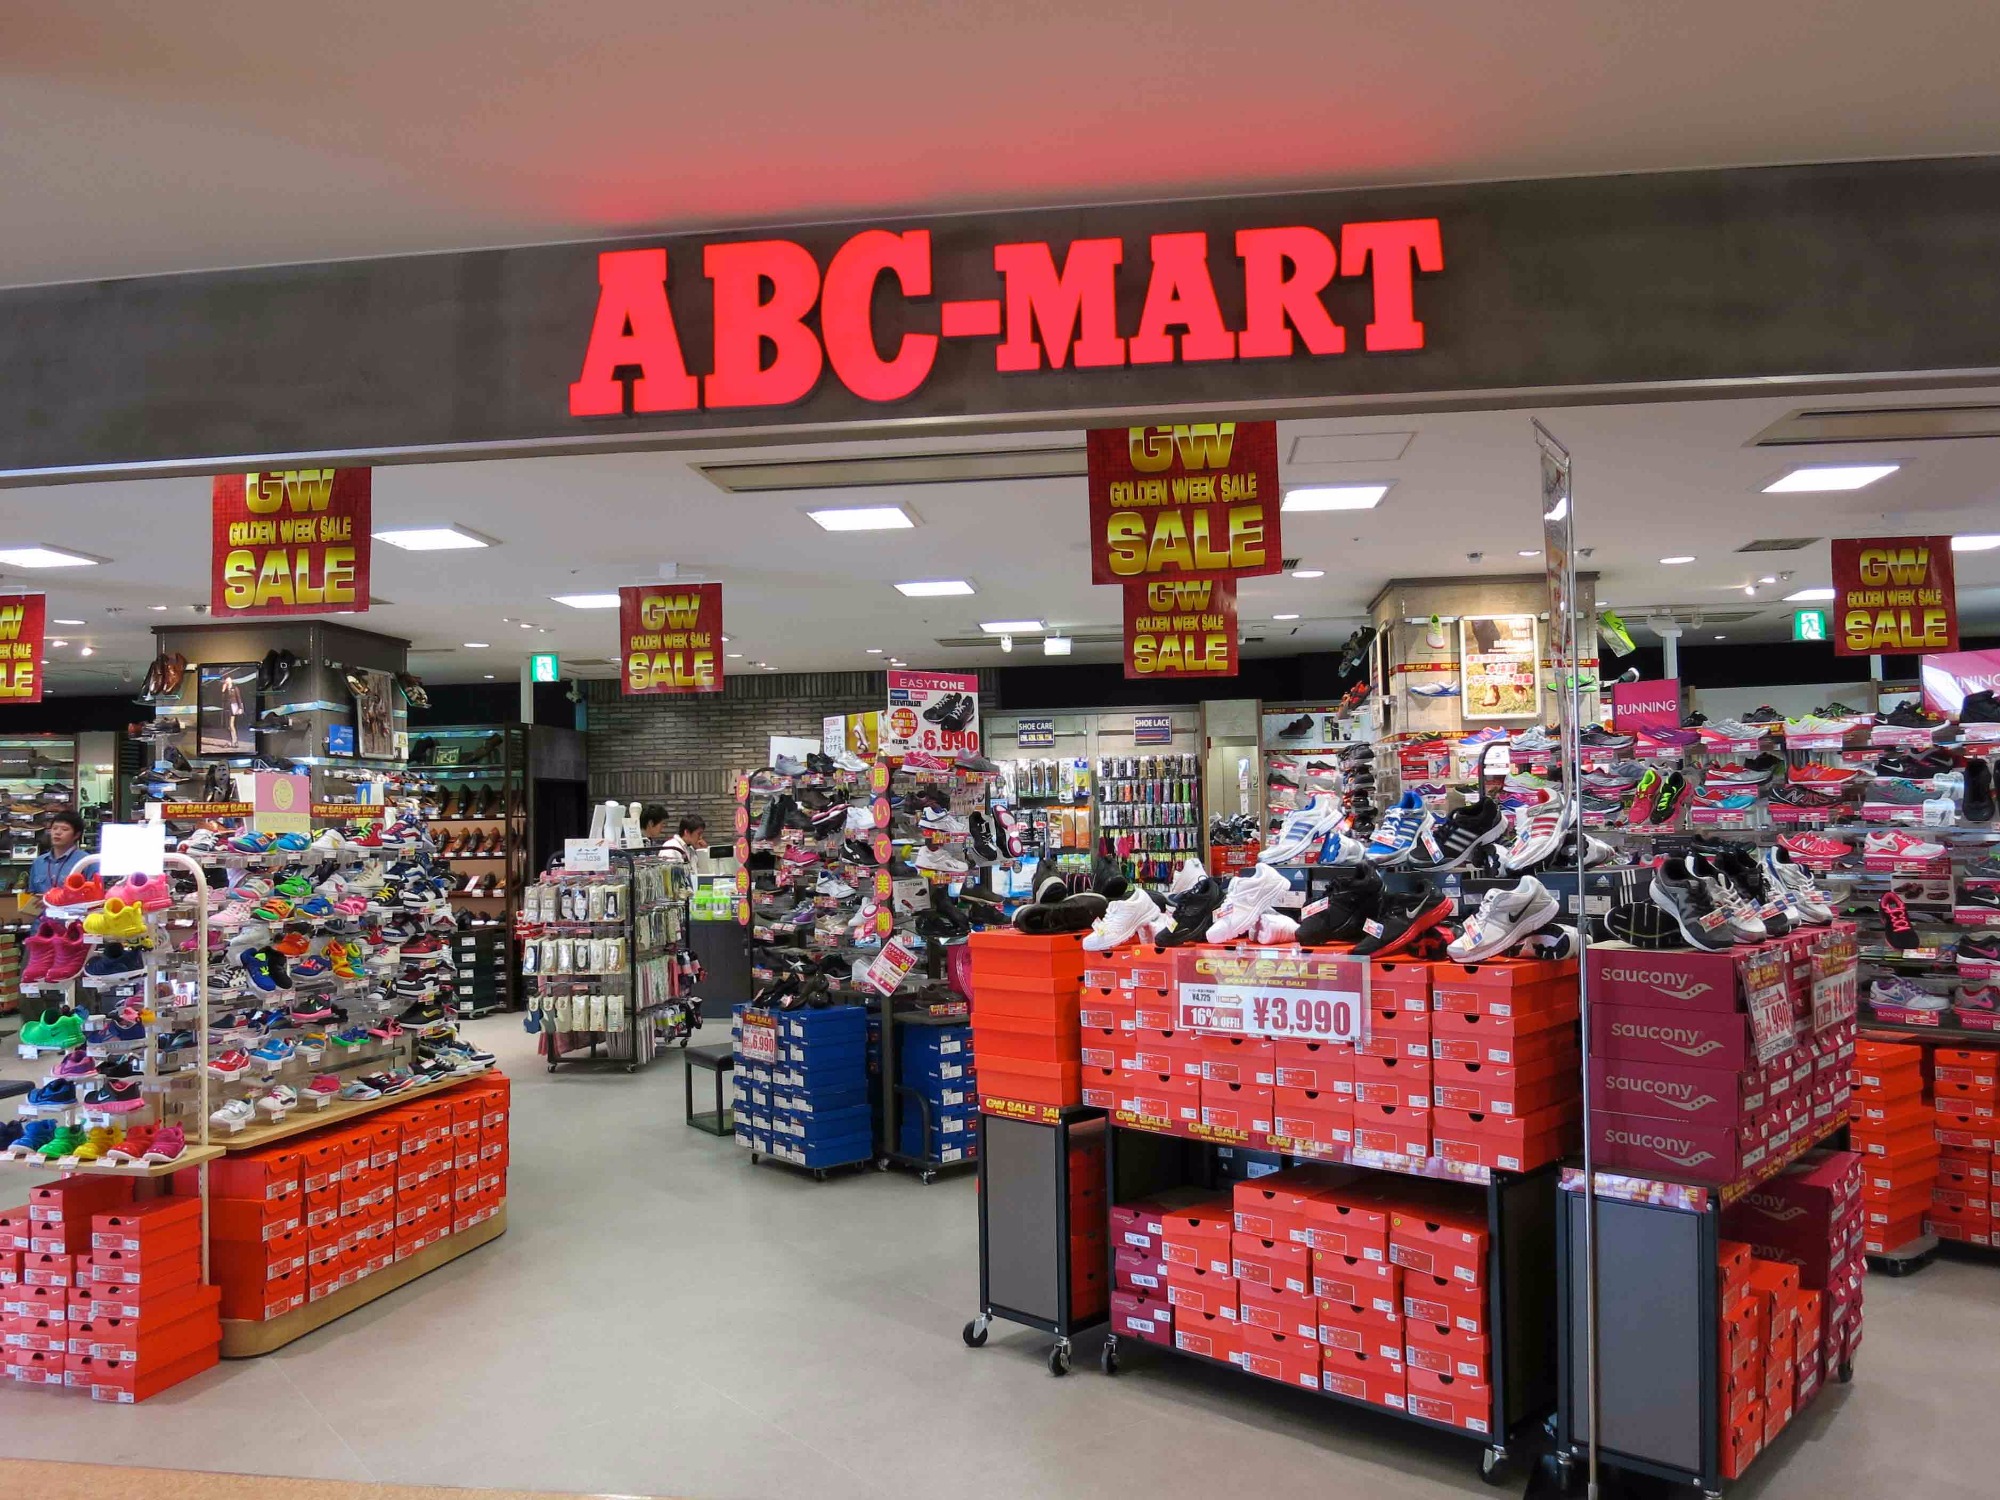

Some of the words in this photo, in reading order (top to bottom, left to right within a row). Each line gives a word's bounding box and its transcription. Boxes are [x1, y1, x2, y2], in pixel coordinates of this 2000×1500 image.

[569, 218, 1444, 418] ABC-MART
[1128, 422, 1237, 473] GW
[246, 468, 336, 514] GW
[1109, 478, 1168, 508] GOLDEN
[1171, 475, 1217, 505] WEEK
[1220, 472, 1258, 502] SALE
[229, 520, 276, 547] GOLDEN
[280, 517, 317, 544] WEEK
[319, 515, 352, 542] SALE
[1107, 504, 1266, 577] SALE
[1859, 547, 1930, 587] GW
[224, 547, 356, 610] SALE
[1148, 579, 1213, 613] GW
[1847, 590, 1885, 608] GOLDEN
[1887, 589, 1916, 607] WEEK
[1918, 588, 1942, 606] SALE
[0, 604, 25, 641] W
[641, 593, 701, 631] GW
[1135, 615, 1171, 633] GOLDEN
[1172, 614, 1200, 632] WEEK
[1201, 613, 1224, 631] SALE
[1845, 608, 1949, 651] SALE
[0, 643, 12, 660] EEK
[13, 642, 32, 660] SALE
[630, 634, 662, 651] GOLDEN
[663, 633, 689, 650] WEEK
[690, 631, 711, 649] SALE
[1133, 633, 1229, 674] SALE
[0, 661, 34, 698] LE
[628, 651, 715, 690] SALE
[899, 678, 966, 691] EASYTONE
[1617, 699, 1677, 716] RUNNING
[1019, 722, 1036, 732] SHOE
[1036, 721, 1053, 731] CARE
[1135, 718, 1153, 728] SHOE
[1153, 717, 1169, 728] LACE
[923, 730, 979, 752] 6,990
[167, 804, 185, 814] GW
[186, 804, 212, 813] SALE
[212, 804, 229, 814] GW
[230, 803, 253, 812] SALE
[312, 806, 330, 814] GW
[331, 806, 347, 814] SALE
[362, 806, 381, 814] SALE
[1195, 958, 1249, 976] GW
[1255, 960, 1338, 981] SALE
[1601, 967, 1688, 989] saucony
[1192, 993, 1211, 1002] ¥4,725
[1190, 1007, 1218, 1027] 16%
[1253, 996, 1351, 1036] ¥3,990
[752, 1034, 774, 1053] 6,990
[1611, 1022, 1699, 1046] saucony
[1605, 1075, 1693, 1100] saucony
[986, 1097, 1006, 1109] GW
[1007, 1101, 1036, 1115] SALE
[1115, 1110, 1139, 1124] GW
[1139, 1114, 1172, 1128] SALE
[1188, 1123, 1213, 1136] GW
[1214, 1126, 1249, 1141] SALE
[1605, 1128, 1691, 1155] saucony
[1266, 1134, 1293, 1148] GW
[1294, 1139, 1333, 1153] SALE
[1740, 1190, 1787, 1211] cony
